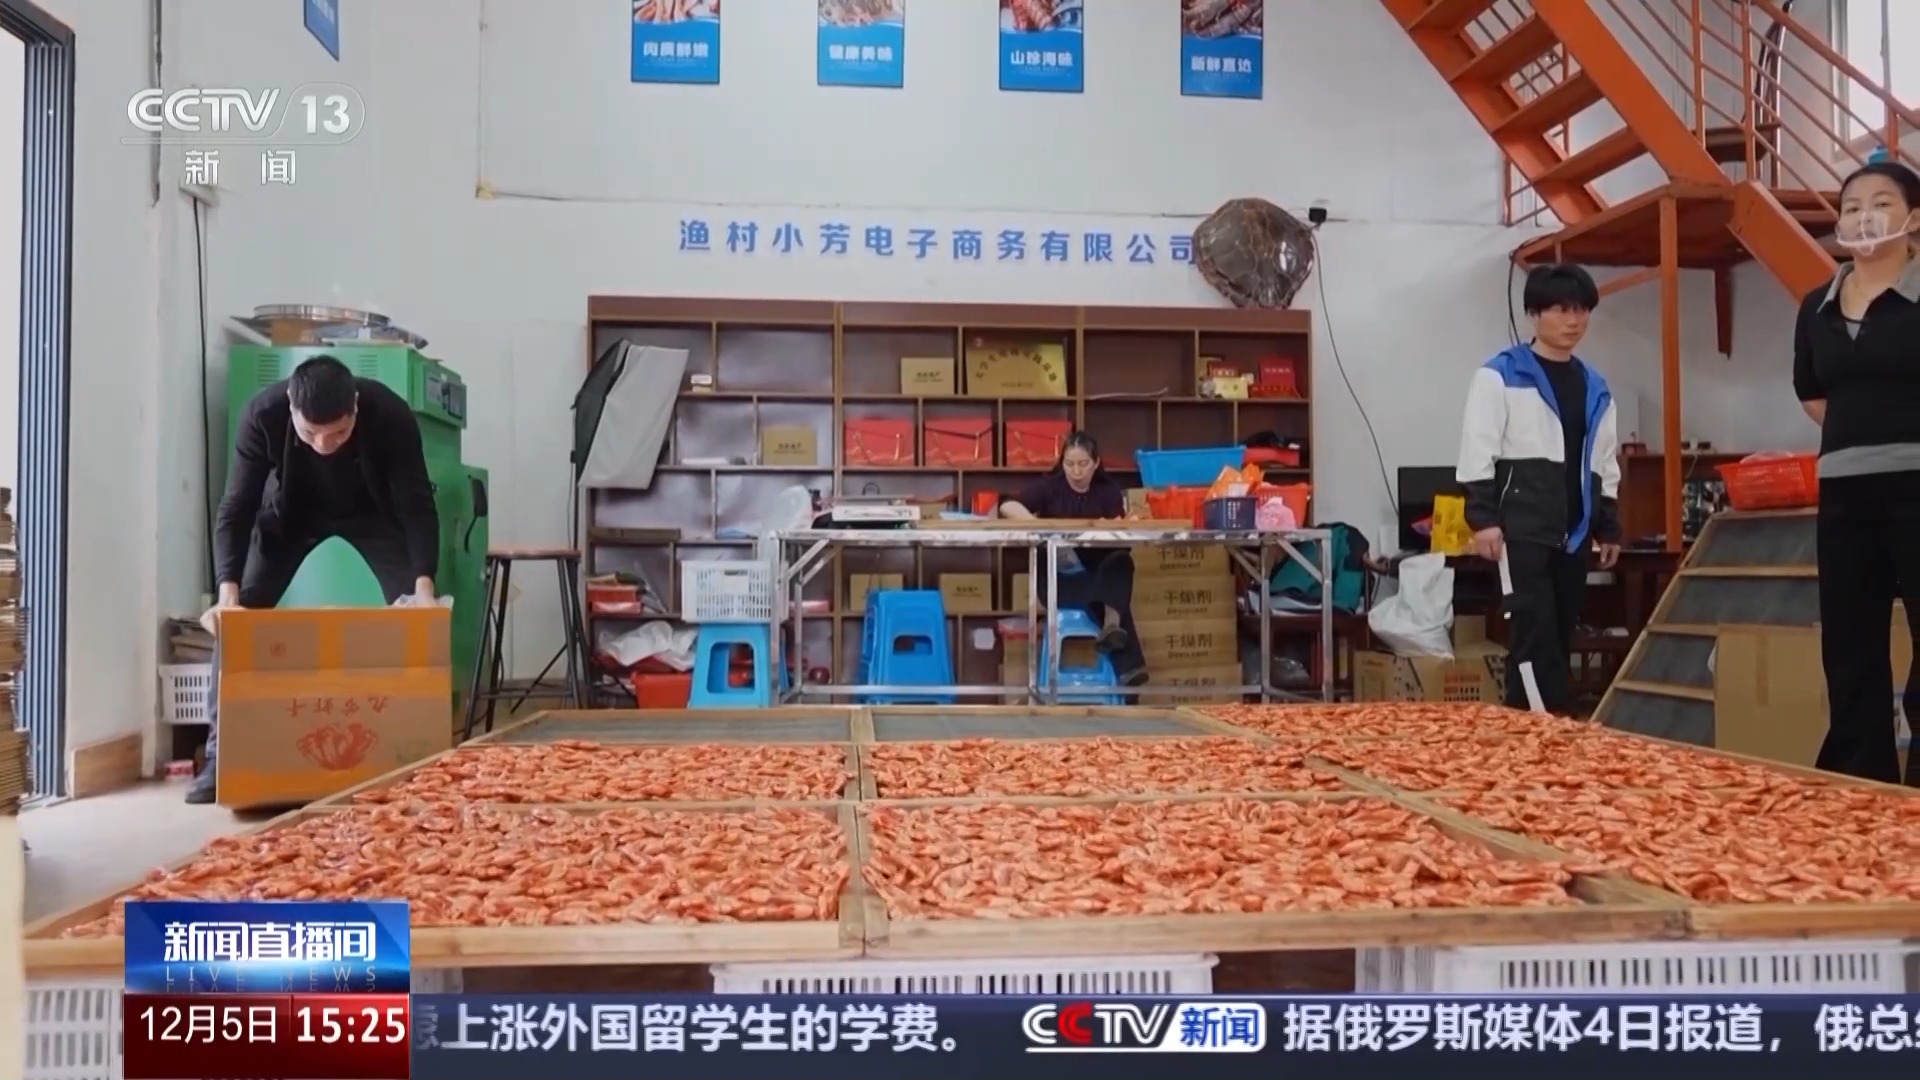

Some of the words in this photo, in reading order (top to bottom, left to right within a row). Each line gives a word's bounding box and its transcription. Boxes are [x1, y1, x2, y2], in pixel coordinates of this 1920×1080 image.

[1010, 50, 1073, 66] 山珍海味
[1191, 56, 1252, 73] 新鲜直达
[679, 219, 1197, 265] 渔村小芳电子商务有限公司
[1164, 590, 1212, 605] 干燥剂
[1165, 633, 1213, 649] 干燥剂
